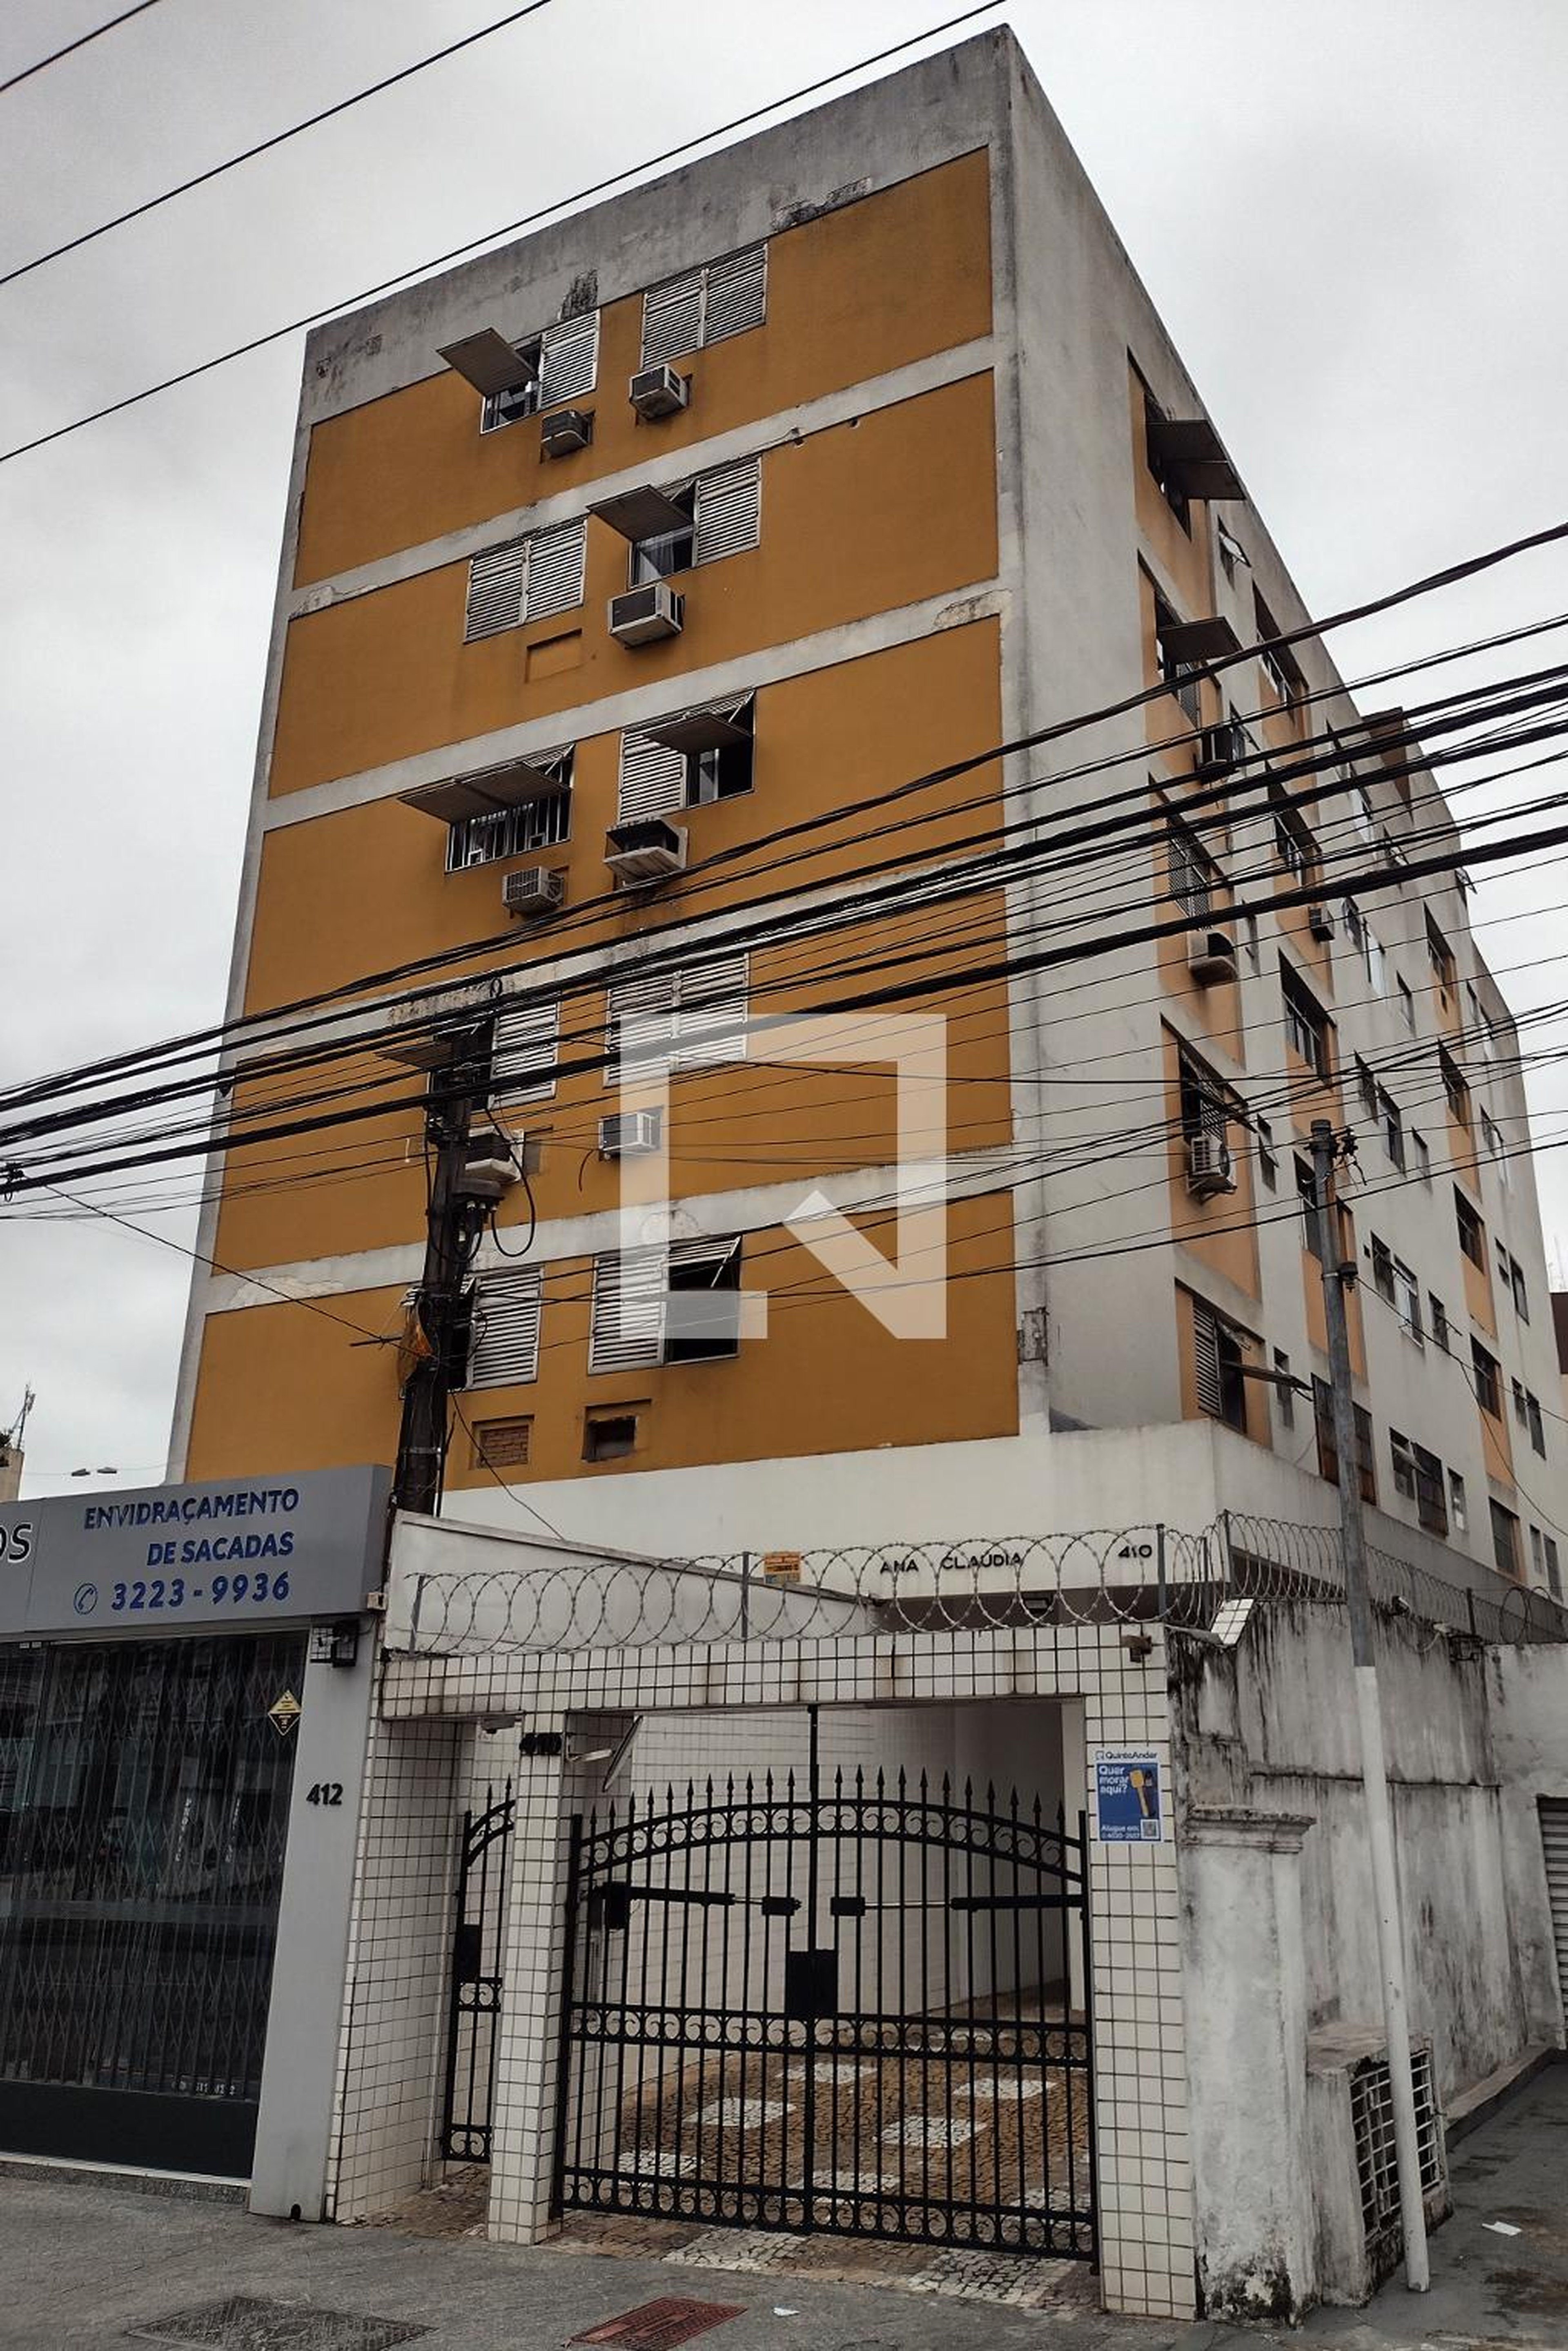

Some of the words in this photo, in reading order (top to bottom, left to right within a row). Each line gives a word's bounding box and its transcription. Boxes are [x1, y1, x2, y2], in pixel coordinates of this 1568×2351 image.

[84, 1488, 299, 1529] ENVIDRAÇAMENTO
[147, 1542, 176, 1566] DE
[181, 1532, 294, 1564] SACADAS
[1118, 1545, 1152, 1558] 410
[880, 1559, 918, 1574] ANA
[942, 1553, 1021, 1570] CLAUDIA
[1099, 1765, 1125, 1775] Quer
[1099, 1776, 1129, 1784] morar
[306, 1783, 343, 1805] 412
[1100, 1784, 1127, 1796] aqui?
